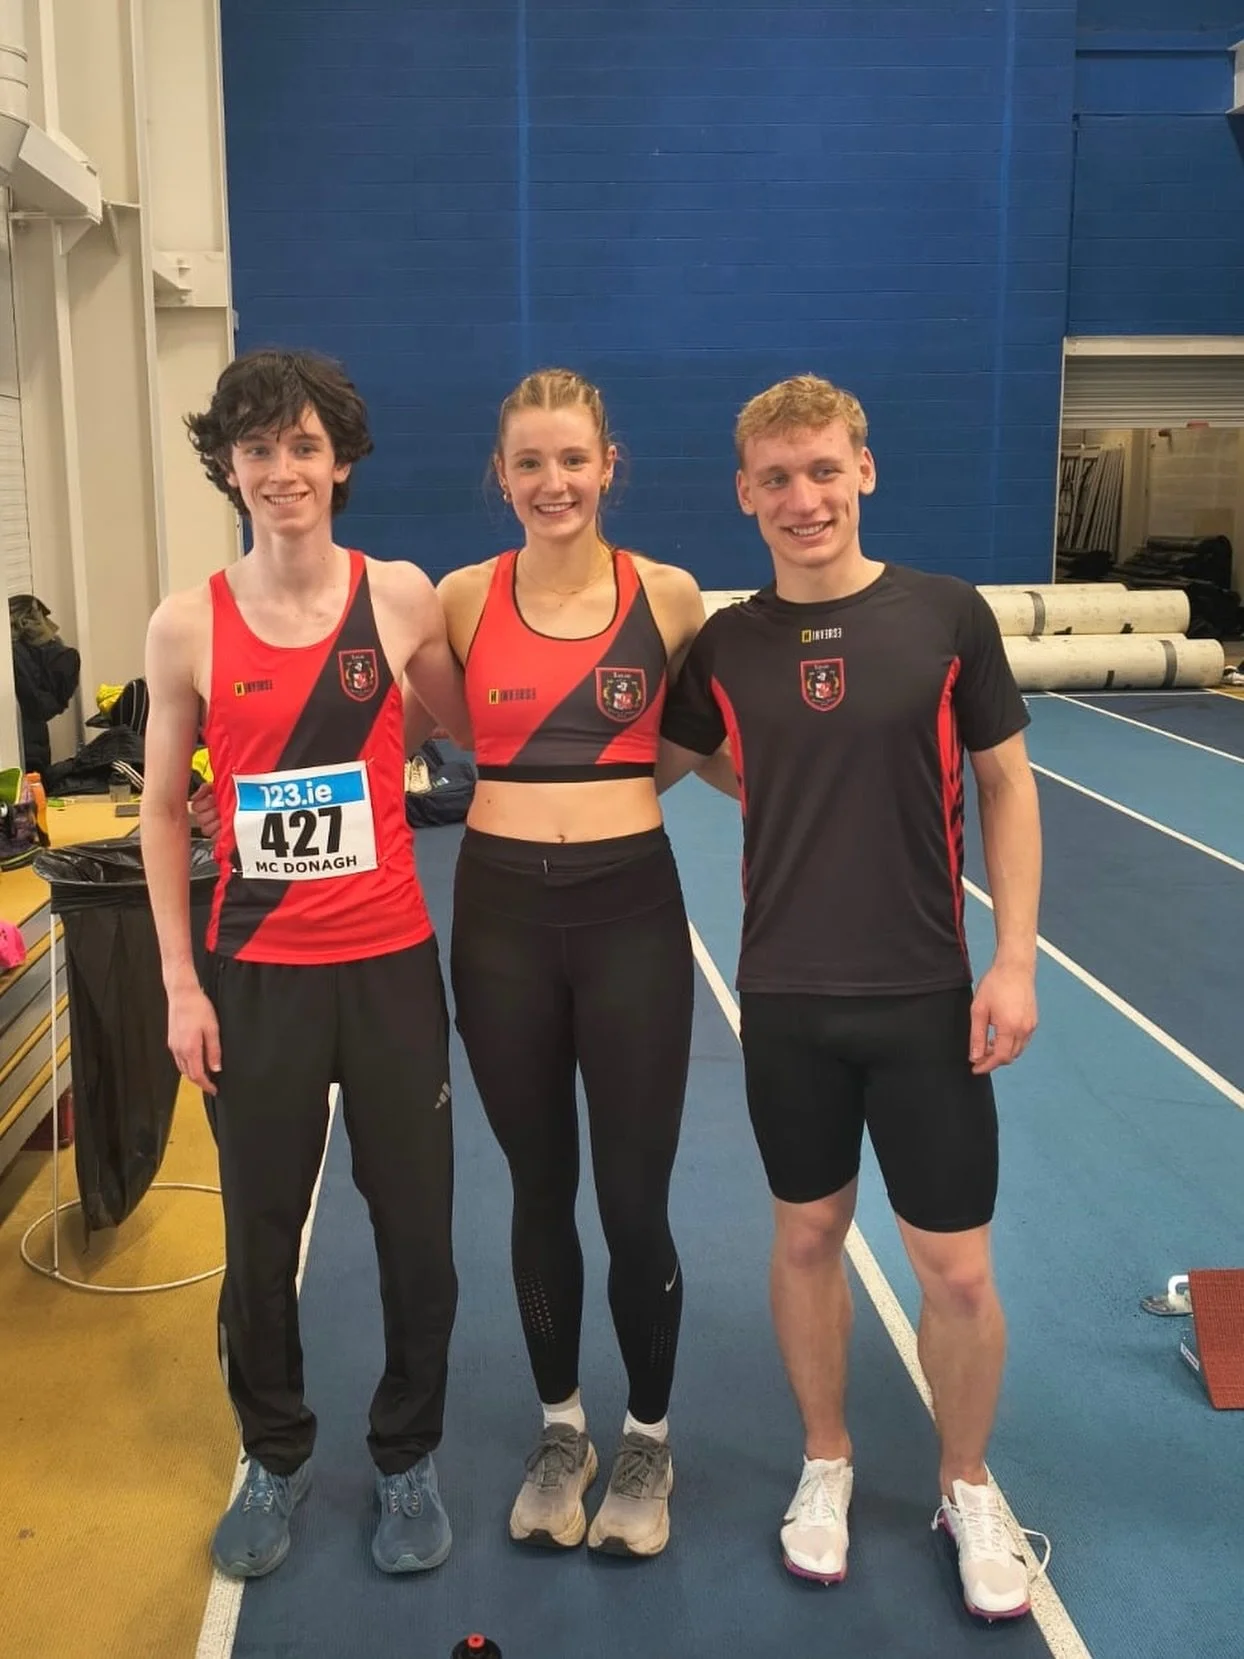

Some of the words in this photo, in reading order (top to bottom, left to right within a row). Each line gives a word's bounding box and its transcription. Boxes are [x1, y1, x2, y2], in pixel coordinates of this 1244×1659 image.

[260, 781, 332, 808] 123.ie
[260, 806, 342, 858] 427
[256, 861, 278, 873] MC
[284, 855, 357, 873] DONAGH
